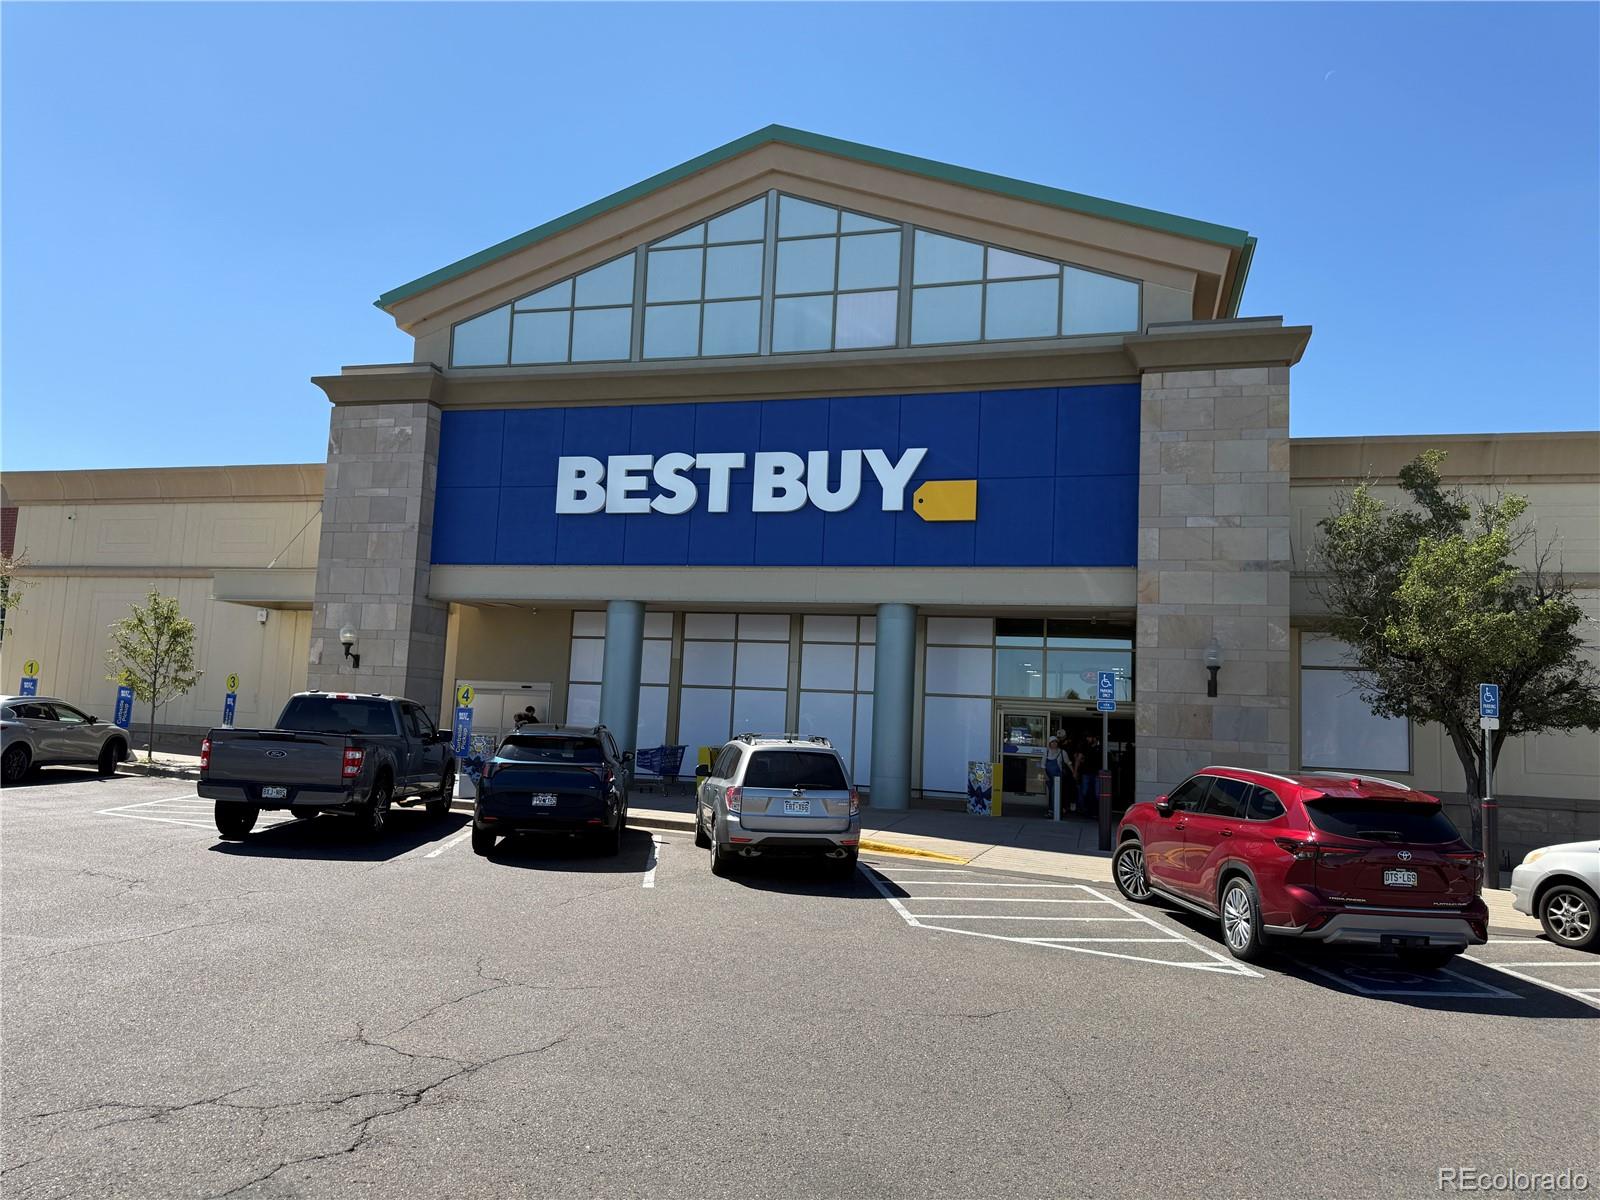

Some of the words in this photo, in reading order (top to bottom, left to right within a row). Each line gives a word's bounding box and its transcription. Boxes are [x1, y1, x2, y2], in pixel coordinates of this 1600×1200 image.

[555, 452, 746, 515] BEST
[752, 447, 928, 513] BUY
[28, 662, 34, 674] 1
[230, 676, 236, 688] 3
[462, 688, 470, 702] 4
[455, 724, 463, 753] Curbside
